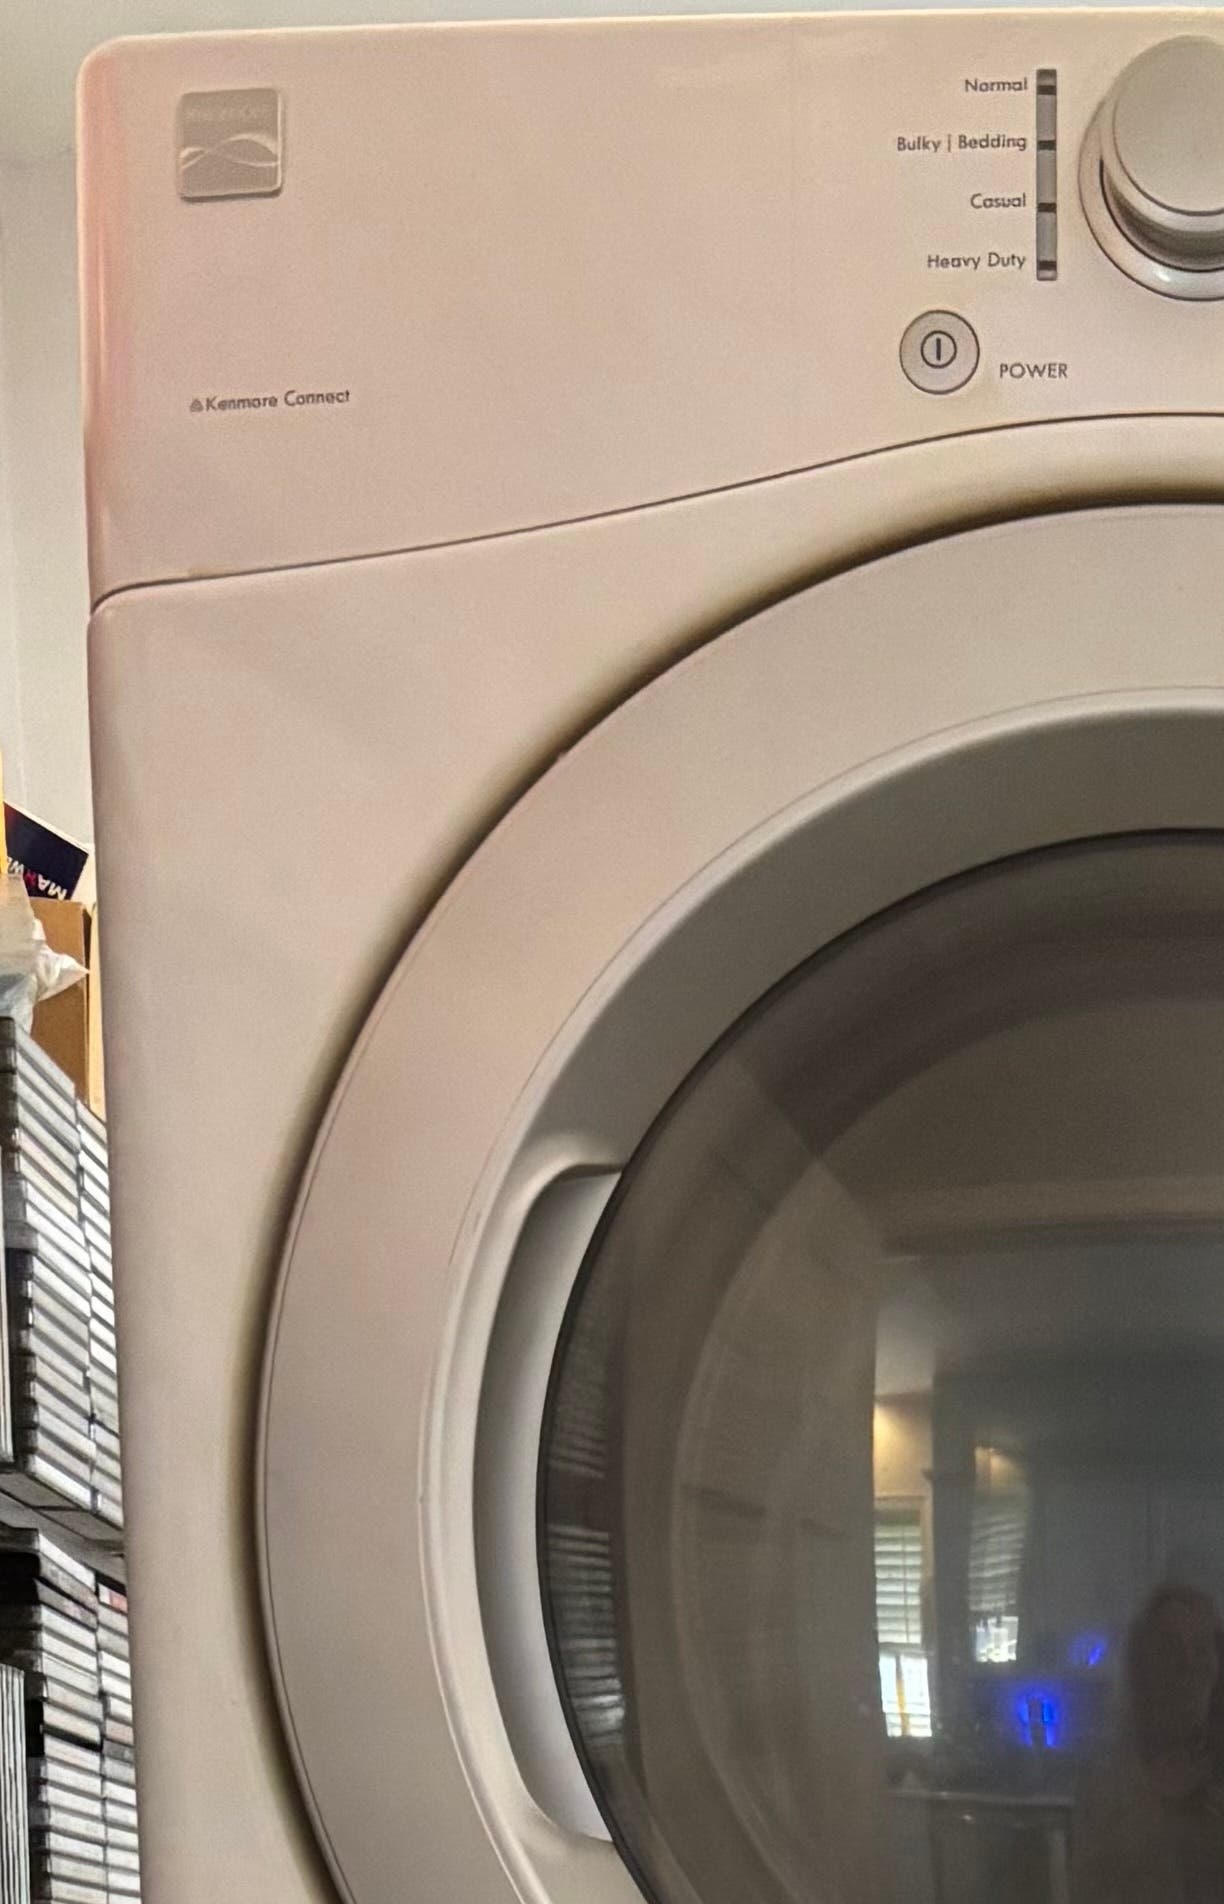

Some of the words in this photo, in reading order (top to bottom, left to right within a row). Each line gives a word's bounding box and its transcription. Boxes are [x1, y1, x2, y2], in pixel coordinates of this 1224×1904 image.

[965, 78, 1027, 92] Normal
[897, 136, 941, 152] Bulky
[959, 134, 1026, 151] Bedding
[970, 193, 1026, 209] Casual
[928, 255, 980, 270] Heavy
[988, 252, 1026, 269] Duty
[1000, 363, 1067, 378] POWER
[206, 396, 278, 411] Kenmore
[284, 390, 350, 406] Connect
